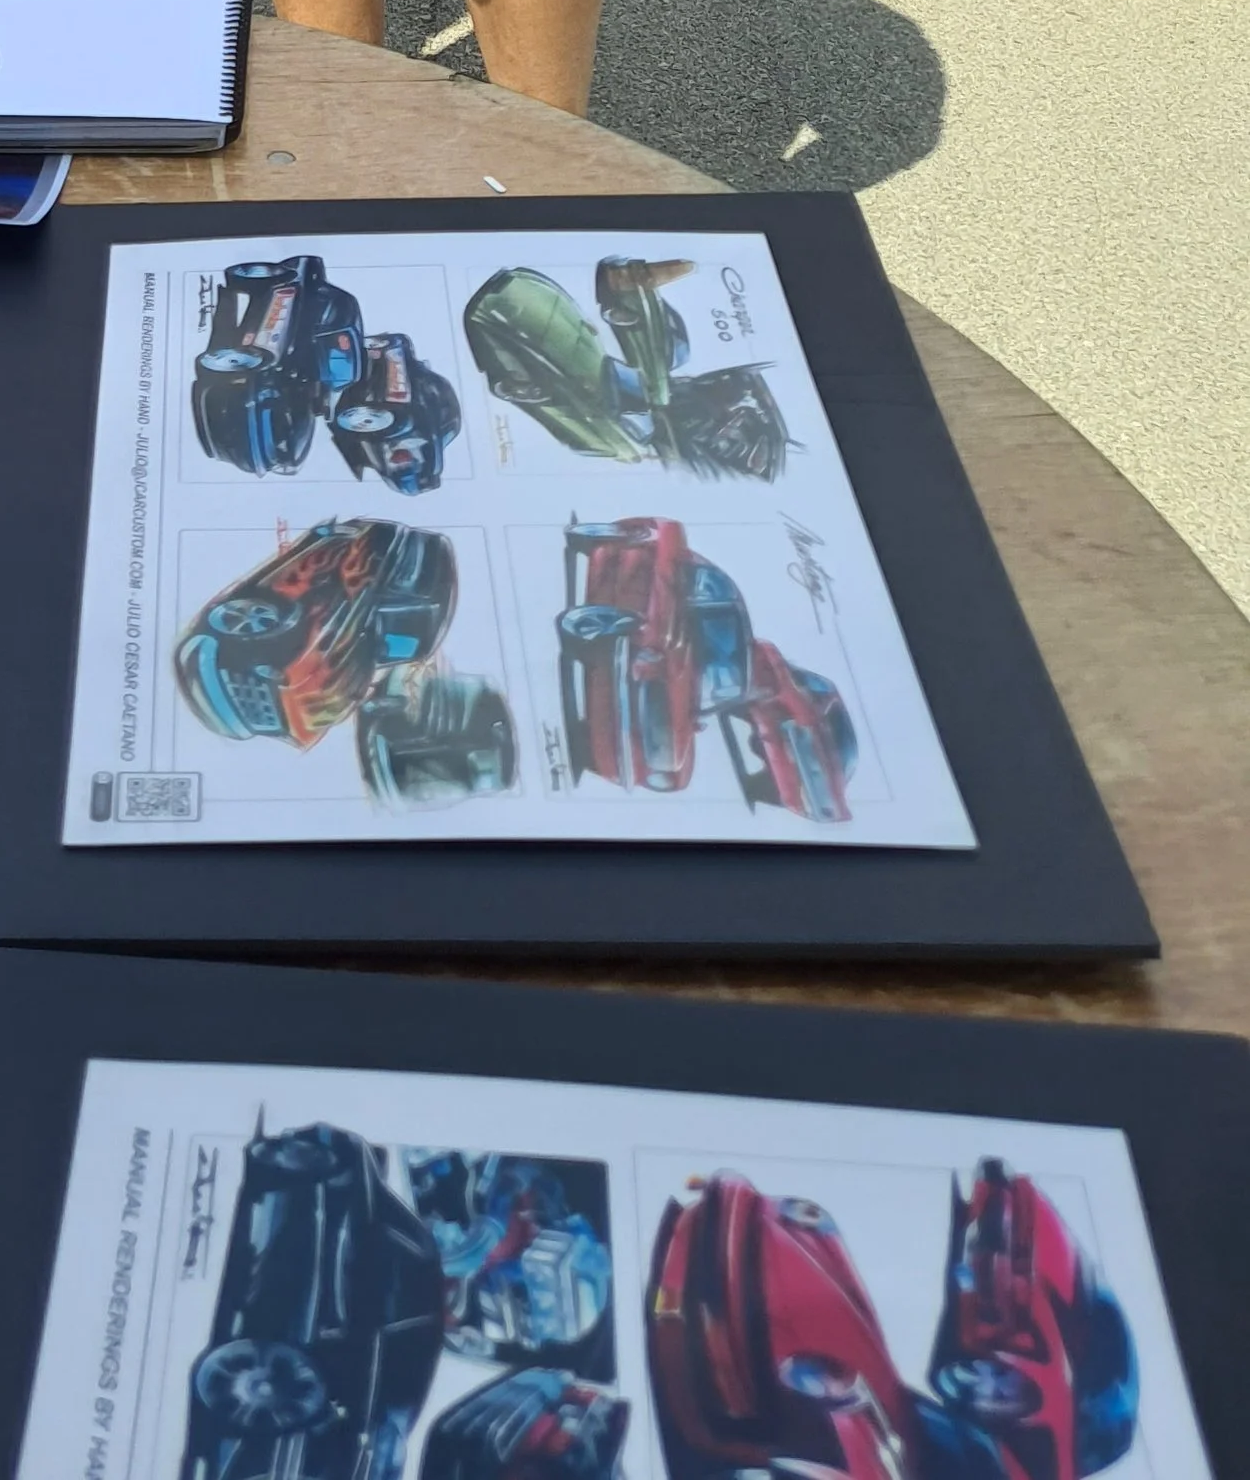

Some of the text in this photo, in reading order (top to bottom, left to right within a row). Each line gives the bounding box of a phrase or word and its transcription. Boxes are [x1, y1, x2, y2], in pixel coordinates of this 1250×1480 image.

[142, 272, 156, 314] MANUAL
[139, 316, 155, 379] RENDERINGS
[137, 394, 151, 425] HAND
[126, 599, 143, 638] JULIO
[124, 641, 141, 690] CESAR
[120, 693, 139, 762] CAETANO
[121, 1127, 150, 1222] MANUAL
[98, 1229, 138, 1391] RENDERINGS
[94, 1396, 115, 1432] BY
